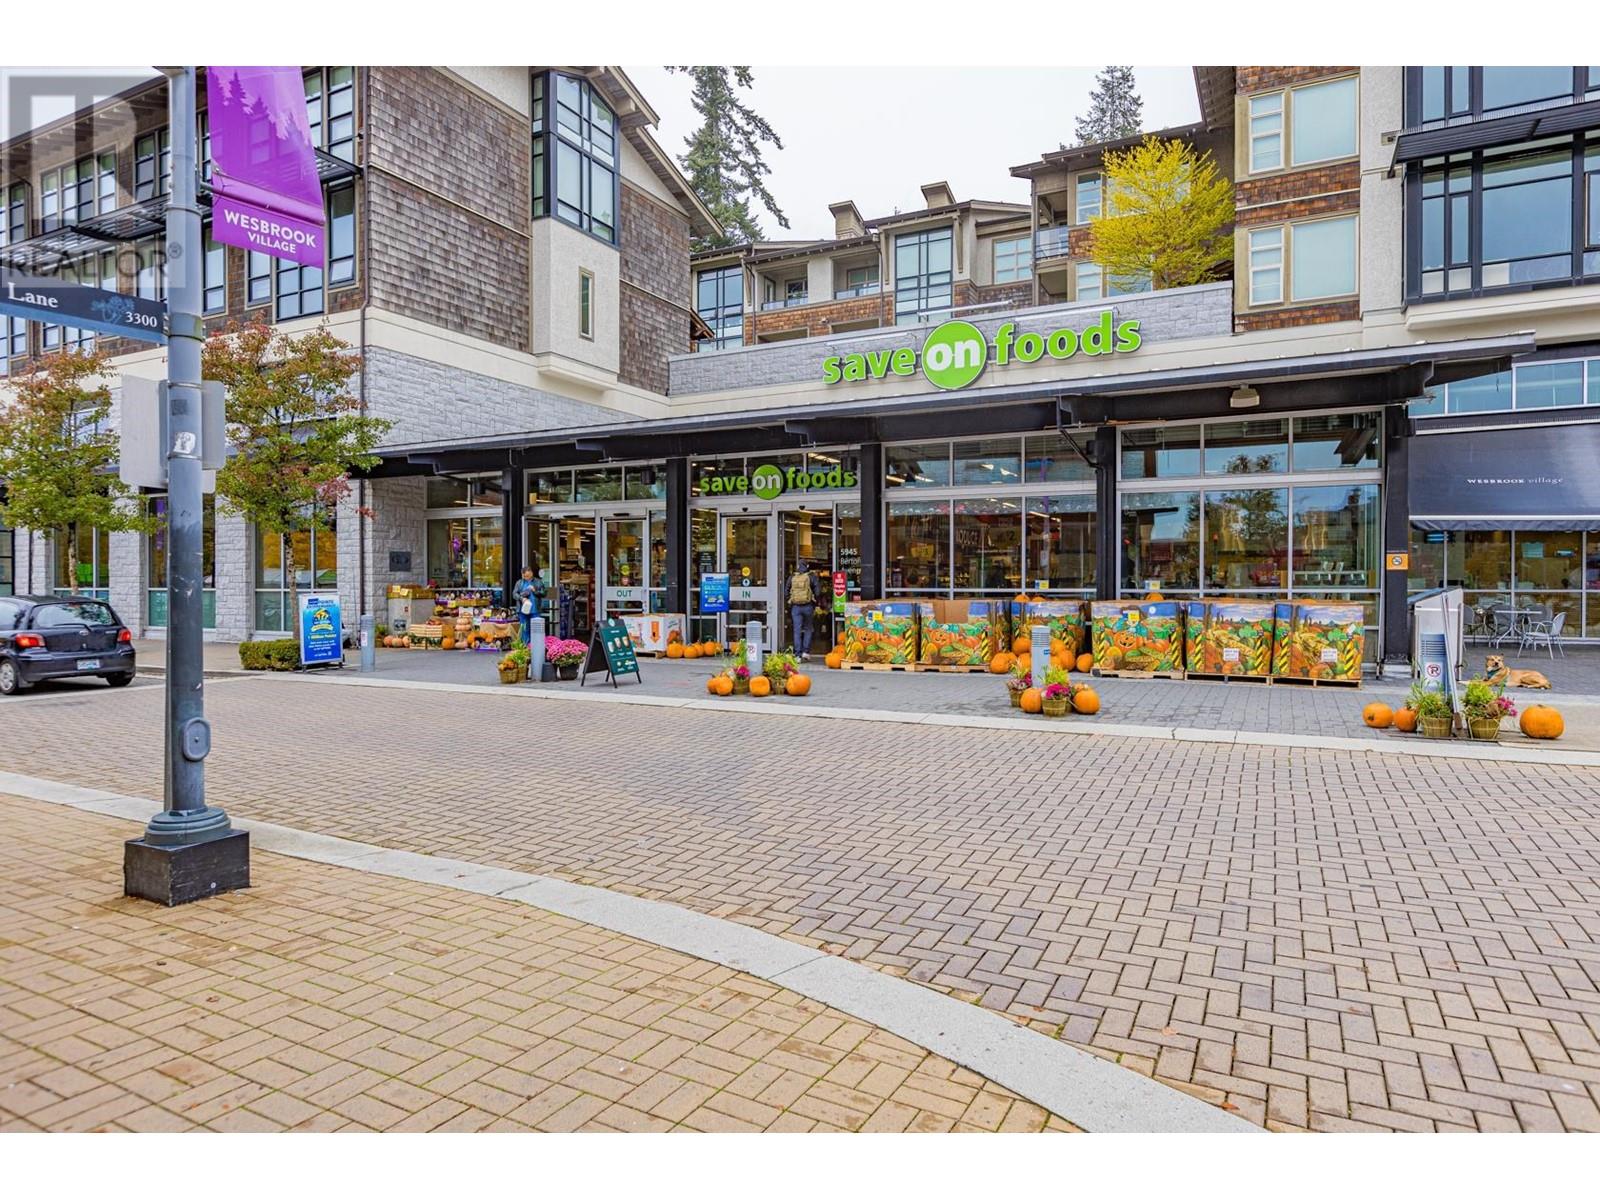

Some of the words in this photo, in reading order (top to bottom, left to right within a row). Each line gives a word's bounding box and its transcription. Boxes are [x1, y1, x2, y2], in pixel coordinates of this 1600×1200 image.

[223, 209, 317, 248] WESBROOK
[247, 231, 297, 254] VILLAGE
[7, 282, 59, 308] Lane
[125, 311, 158, 328] 3300
[822, 346, 916, 385] save
[926, 337, 981, 372] on
[994, 310, 1142, 366] foods
[700, 475, 749, 493] save
[752, 474, 781, 489] on
[786, 465, 857, 490] foods
[840, 548, 858, 556] 5945
[616, 590, 632, 598] OUT
[742, 591, 751, 599] IN
